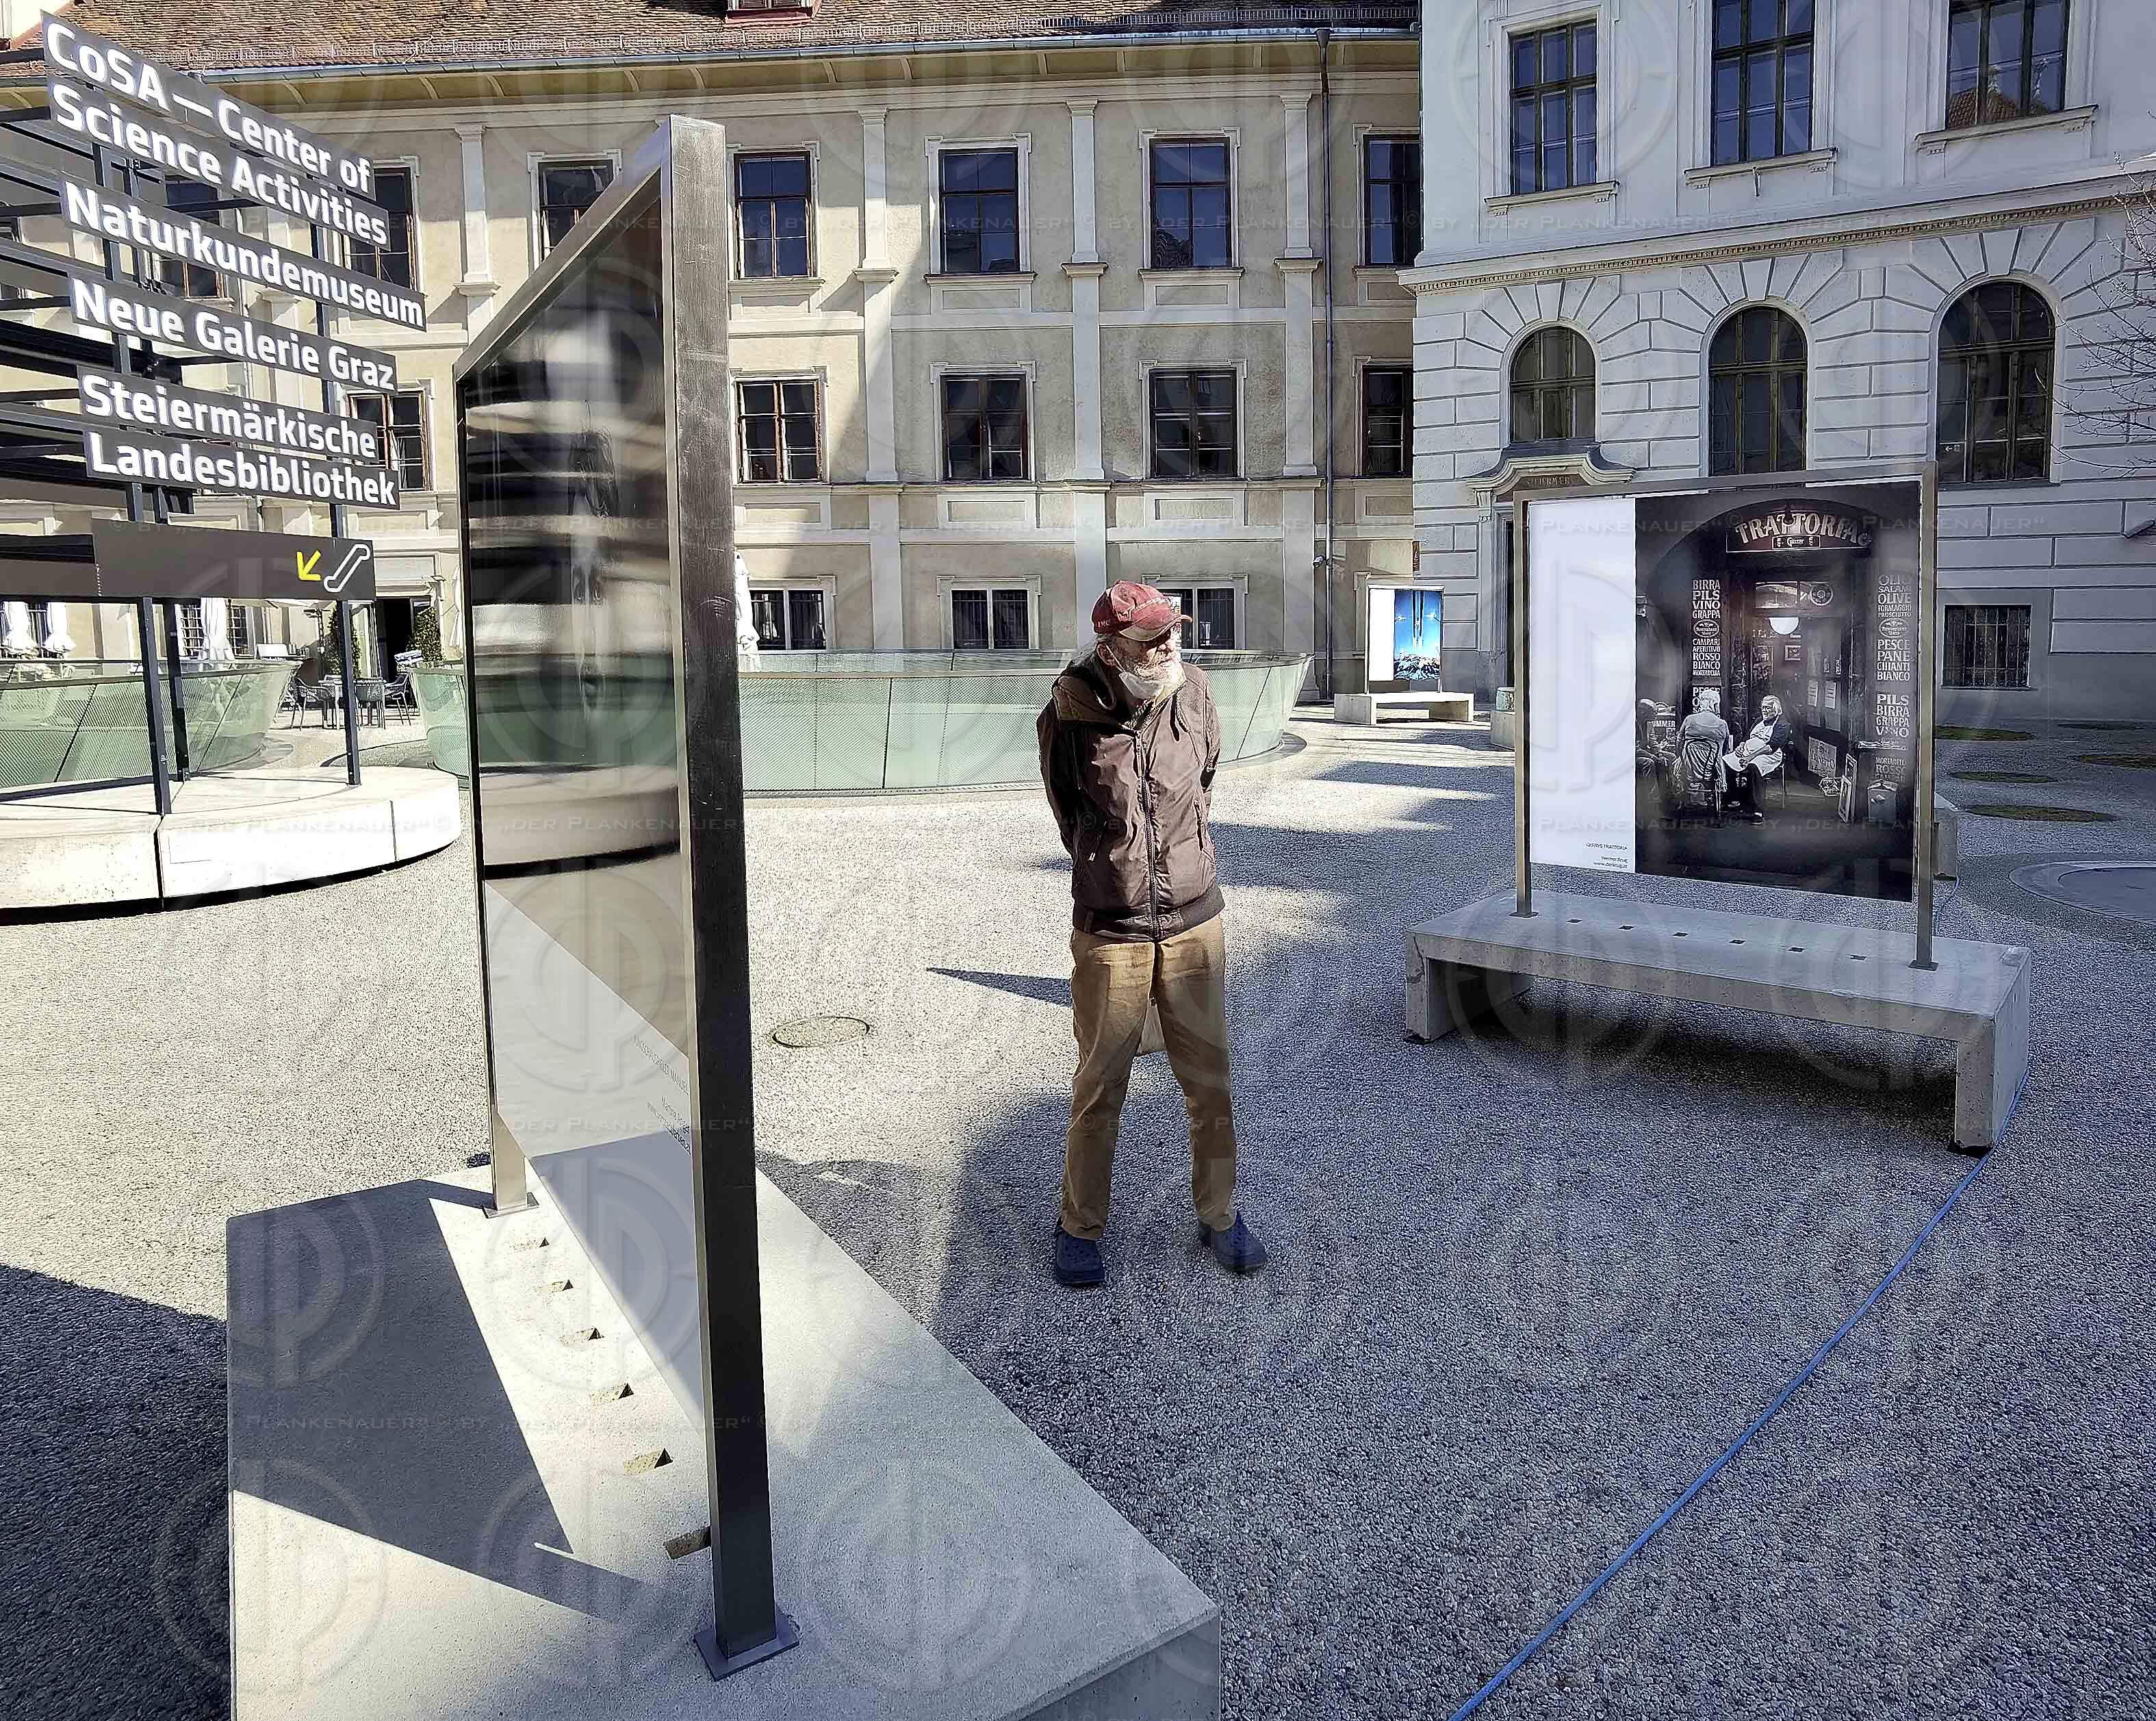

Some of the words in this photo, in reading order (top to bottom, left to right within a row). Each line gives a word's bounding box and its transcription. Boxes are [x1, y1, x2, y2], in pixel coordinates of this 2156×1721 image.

[47, 23, 170, 112] CoSA
[218, 99, 332, 177] Center
[339, 157, 372, 193] of
[53, 84, 222, 184] Science
[231, 156, 387, 245] Activities
[66, 181, 424, 327] Naturkundemuseum
[73, 278, 185, 342] Neue
[196, 311, 320, 373] Galerie
[328, 345, 395, 390] Graz
[84, 374, 376, 457] Steiermärkische
[89, 432, 396, 505] Landesbibliothek
[1736, 513, 1858, 544] TRATTORIA
[1693, 579, 1721, 590] BIRRA
[1693, 590, 1720, 600] PILS
[1878, 593, 1911, 604] OLIVE
[1693, 600, 1721, 610] VINO
[1693, 609, 1721, 619] GRAPPA
[1693, 638, 1721, 646] CAMPARI
[1877, 639, 1911, 651] PESCE
[1693, 652, 1721, 661] ROSSO
[1877, 650, 1911, 662] PANE
[1693, 661, 1721, 670] BIANCO
[1877, 661, 1910, 672] CHIANTI
[1877, 671, 1910, 681] BIANCO
[1877, 693, 1910, 706] PILS
[1876, 705, 1910, 717] BIRRA
[1876, 717, 1910, 727] GRAPPA
